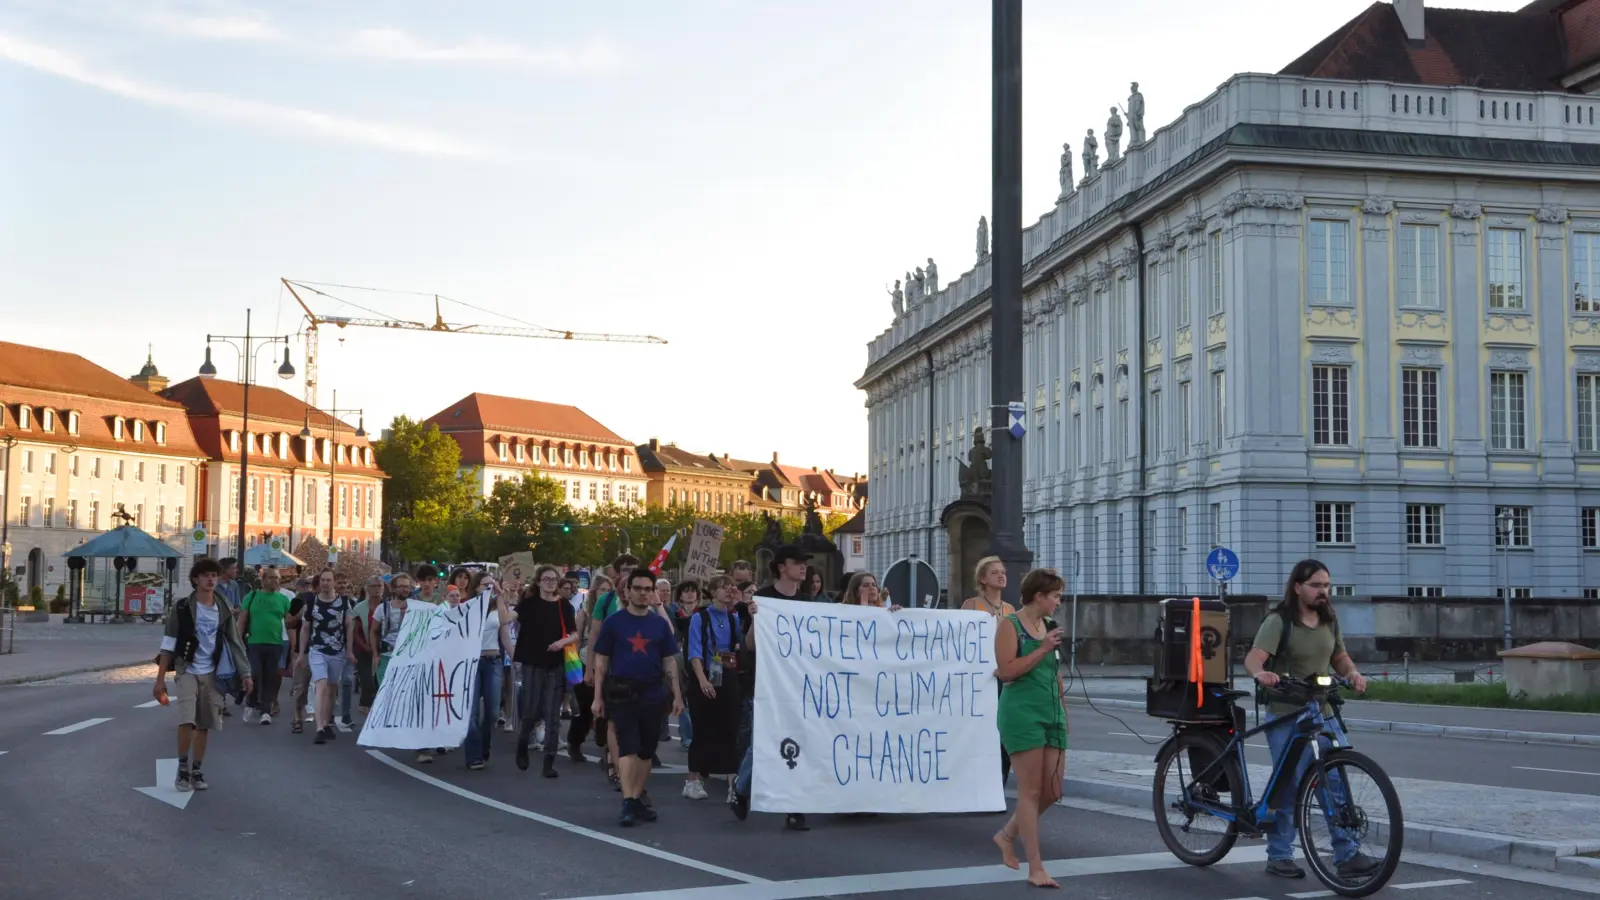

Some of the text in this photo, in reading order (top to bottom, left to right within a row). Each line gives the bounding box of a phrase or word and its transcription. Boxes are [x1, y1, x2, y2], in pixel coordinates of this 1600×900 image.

[695, 522, 720, 539] LOVE
[699, 540, 711, 552] IS
[690, 549, 718, 568] IN THE
[687, 563, 708, 577] AIR
[776, 614, 989, 664] SYSTEM CHANGE
[802, 671, 984, 719] NOT CLIMATE
[833, 728, 949, 786] CHANGE
